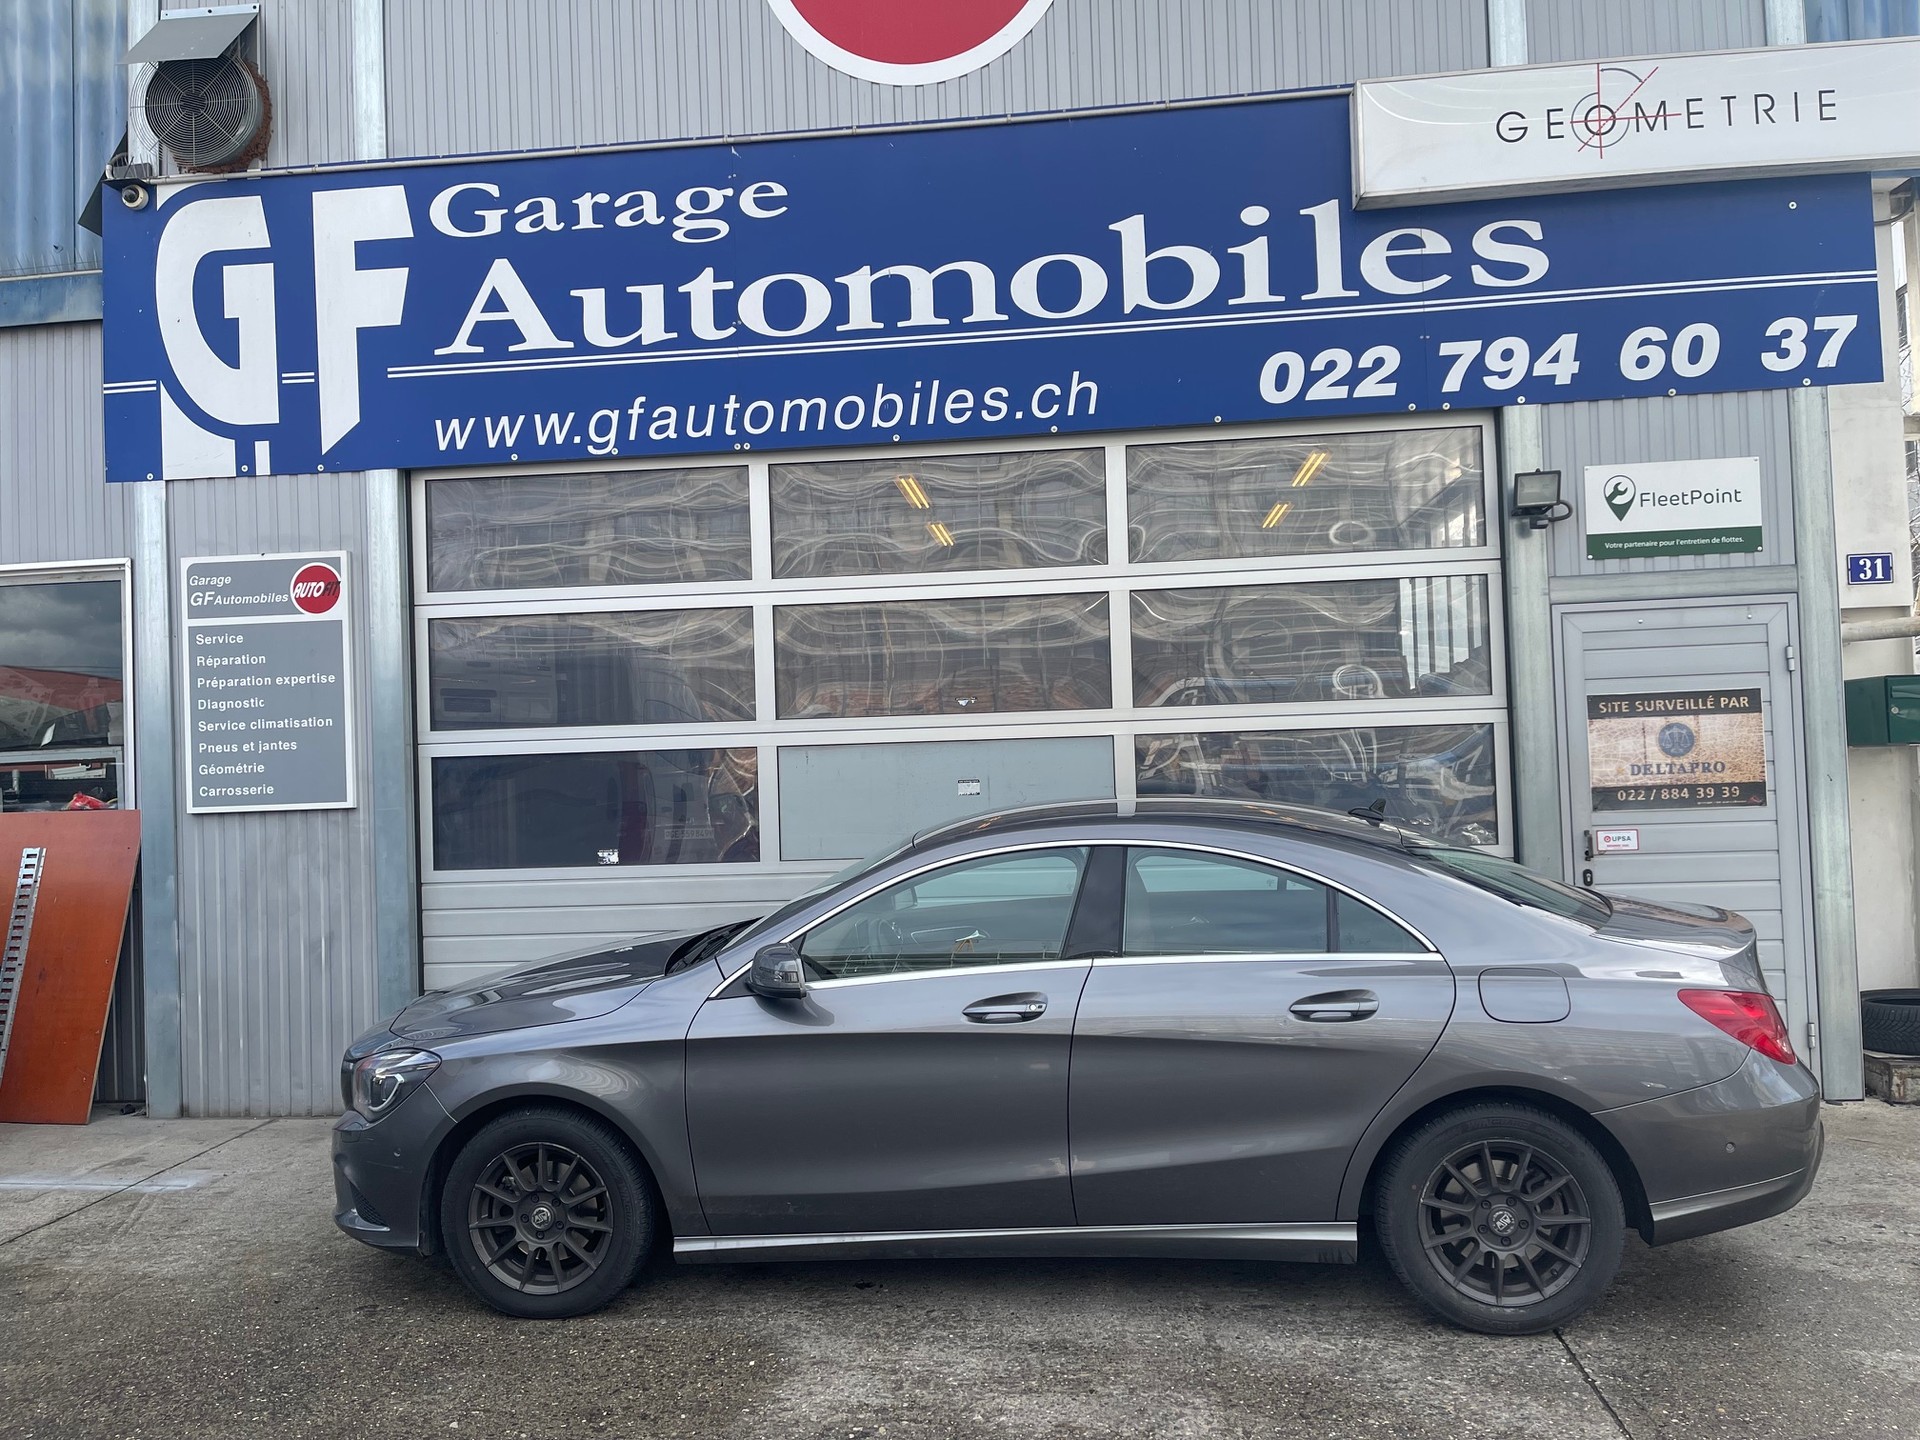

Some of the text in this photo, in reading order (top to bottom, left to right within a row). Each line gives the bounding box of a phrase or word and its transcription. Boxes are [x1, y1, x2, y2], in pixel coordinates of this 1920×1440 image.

[1496, 89, 1838, 144] GEOMETRIE
[428, 180, 789, 244] Garage
[433, 198, 1551, 356] Automobiles
[154, 184, 415, 455] GF
[1258, 314, 1859, 405] 022 794 60 37
[433, 370, 1099, 455] www.gfautomobiles.ch
[1640, 488, 1743, 508] FleetPoint
[1604, 541, 1623, 549] Votre
[1624, 540, 1659, 549] partenaire
[1659, 540, 1676, 548] pour
[1676, 538, 1711, 546] l'entretien
[1859, 558, 1885, 580] 31
[189, 575, 232, 588] Garage
[190, 591, 289, 607] GF Automobiles
[195, 633, 244, 645] Service
[196, 654, 267, 668] Réparation
[197, 673, 336, 690] Préparation expertise
[197, 697, 265, 712] Diagnostic
[1599, 695, 1750, 713] SITE SURVEILLÉ PAR
[198, 717, 333, 732] Service climatisation
[199, 740, 298, 754] Pneus et jantes
[198, 762, 265, 775] Géométrie
[1630, 761, 1726, 776] DELTAPRO
[199, 784, 275, 797] Carrosserie
[1617, 786, 1740, 801] 022 / 884 39 39
